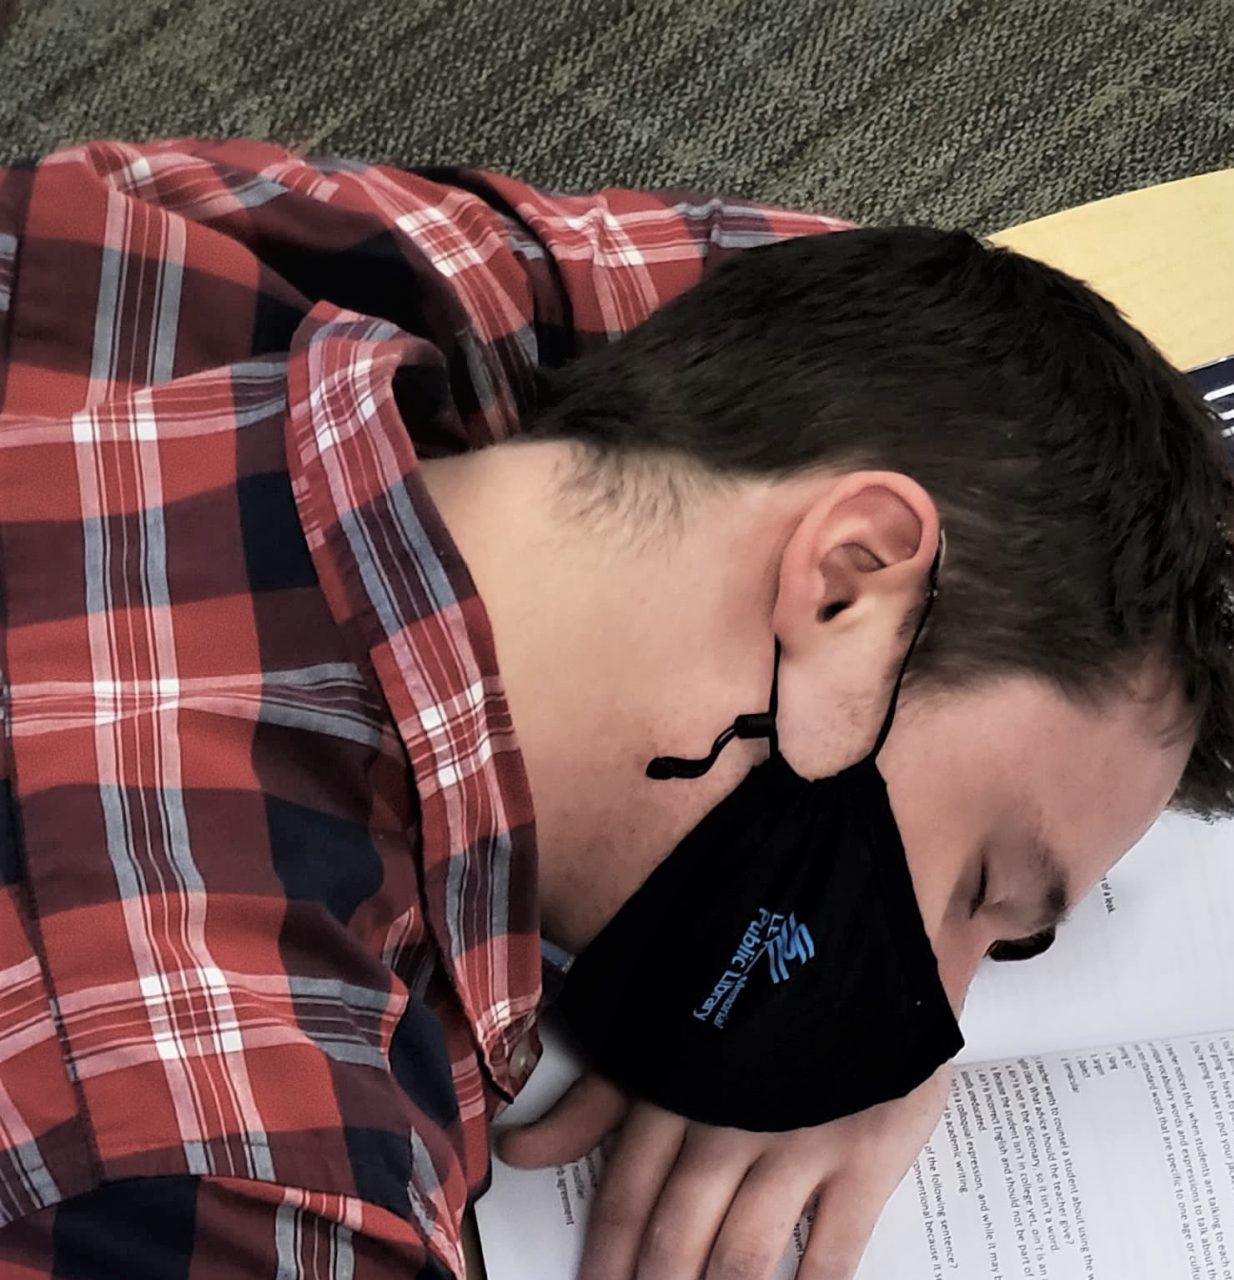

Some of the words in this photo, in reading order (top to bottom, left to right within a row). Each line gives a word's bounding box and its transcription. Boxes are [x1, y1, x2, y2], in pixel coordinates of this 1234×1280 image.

[730, 907, 770, 968] Public
[693, 970, 742, 1021] Library
[1028, 1085, 1041, 1105] What
[1034, 1106, 1048, 1131] advice
[1187, 1111, 1200, 1136] when
[924, 1144, 935, 1155] of
[944, 1120, 961, 1158] academic
[1041, 1131, 1057, 1161] should
[926, 1155, 937, 1172] the
[1048, 1162, 1059, 1179] the
[1194, 1136, 1210, 1177] students
[556, 1177, 574, 1226] agreement
[930, 1172, 946, 1217] following
[1052, 1180, 1067, 1217] teacher
[1203, 1178, 1214, 1195] are
[1207, 1195, 1221, 1230] talking
[924, 1219, 938, 1261] because
[932, 1263, 942, 1271] it
[939, 1218, 959, 1269] sentence?
[1058, 1219, 1075, 1245] give?
[1214, 1230, 1224, 1243] to
[1217, 1243, 1231, 1268] each
